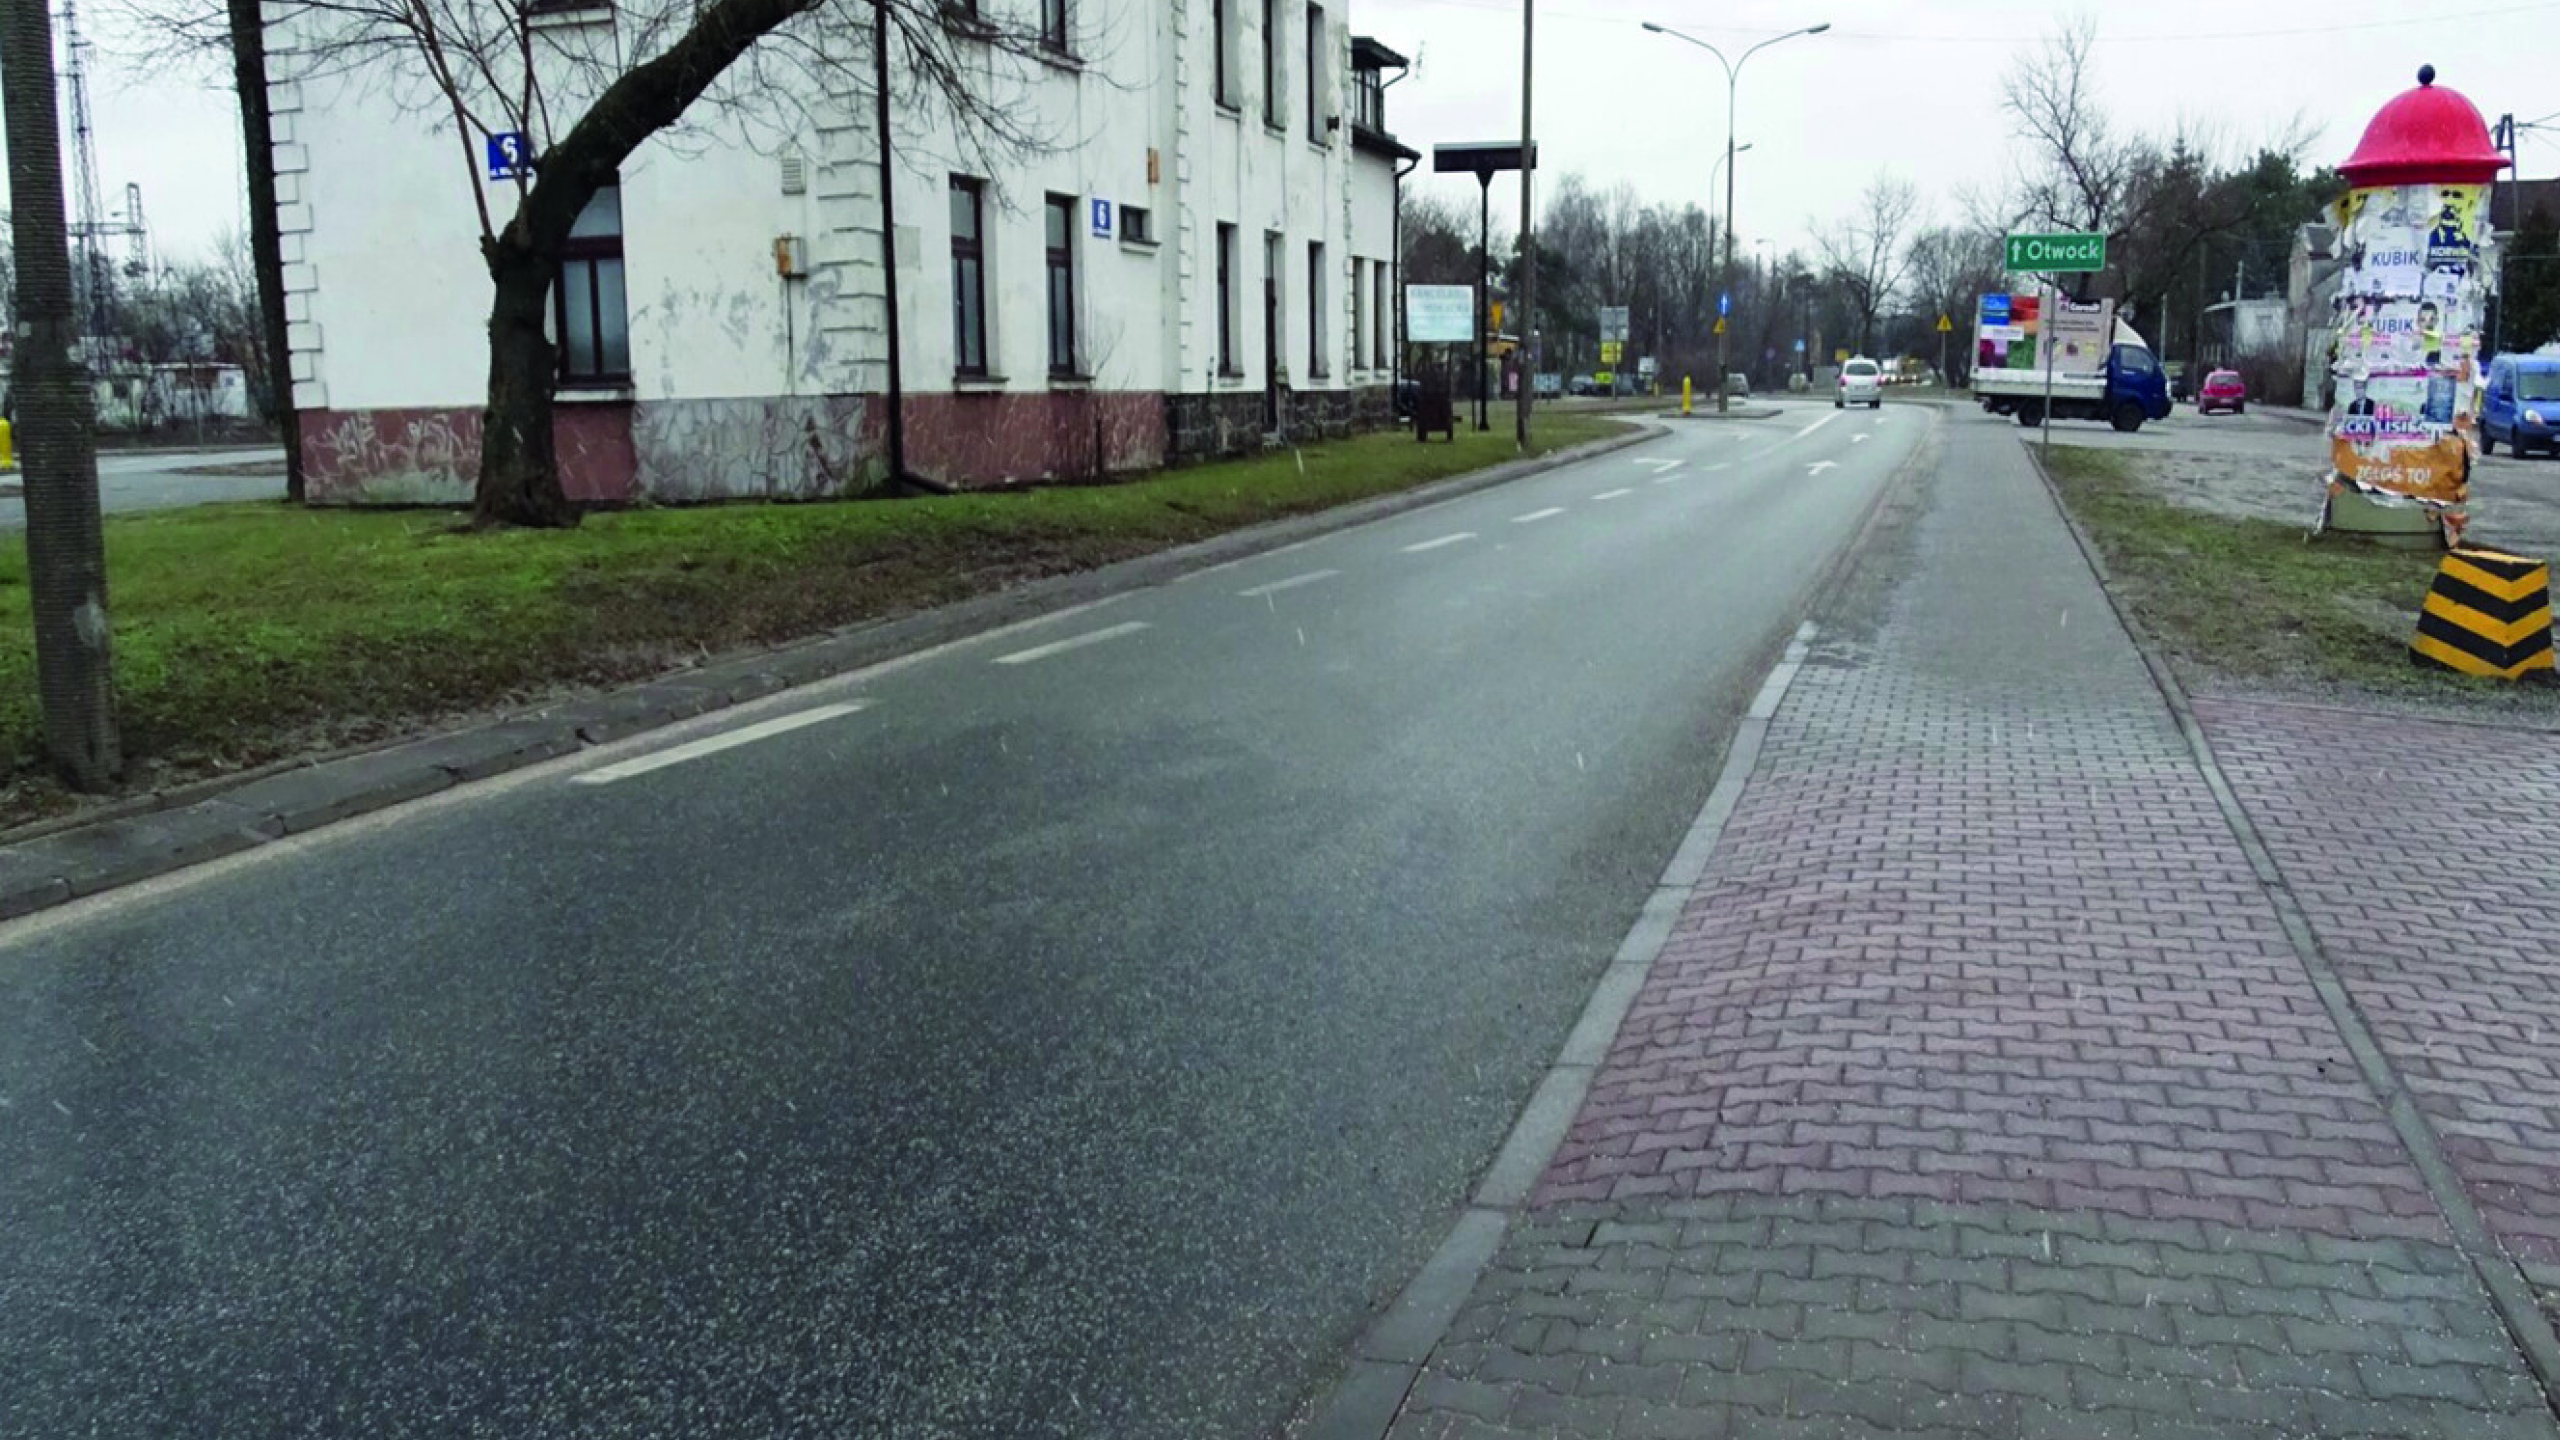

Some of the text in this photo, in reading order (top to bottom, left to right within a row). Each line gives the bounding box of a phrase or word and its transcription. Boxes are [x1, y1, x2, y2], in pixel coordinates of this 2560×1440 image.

[1098, 203, 1107, 226] 6
[2027, 239, 2100, 261] Otwock
[2371, 251, 2419, 266] KUBIK
